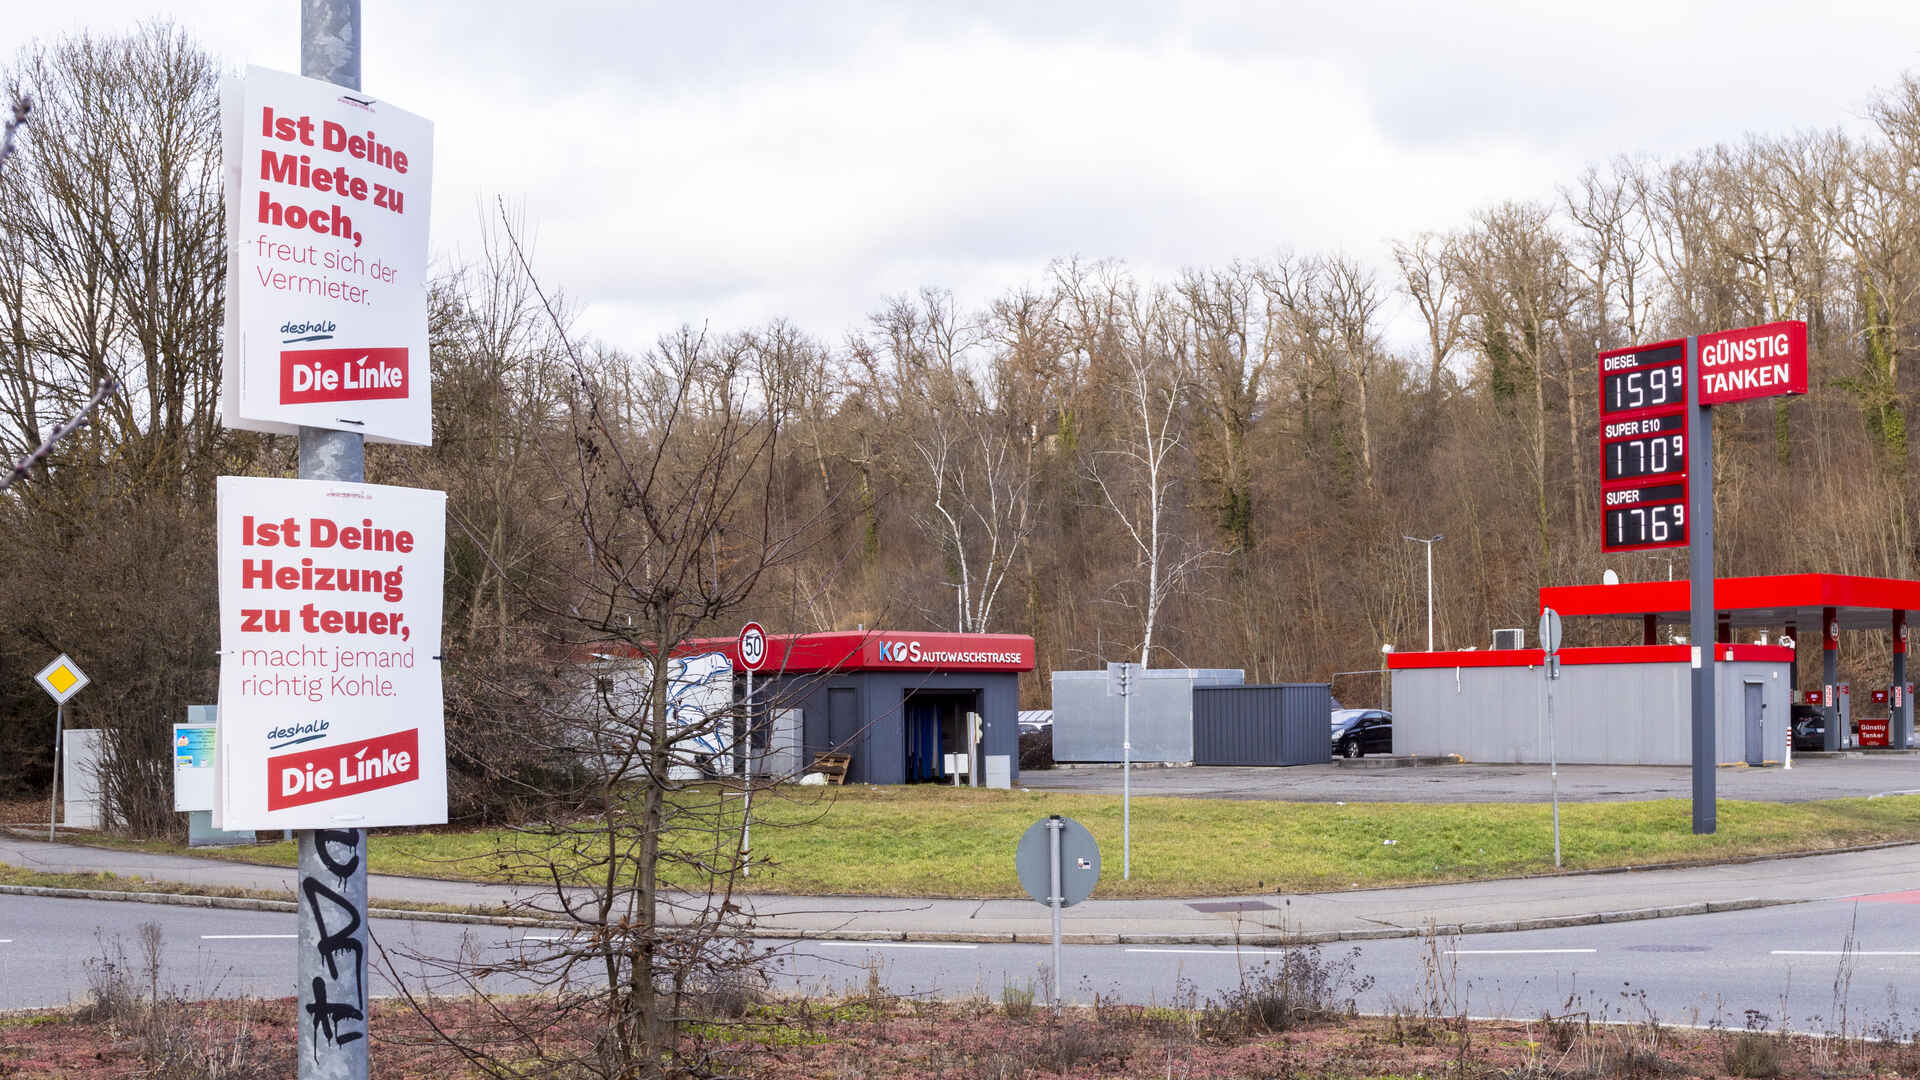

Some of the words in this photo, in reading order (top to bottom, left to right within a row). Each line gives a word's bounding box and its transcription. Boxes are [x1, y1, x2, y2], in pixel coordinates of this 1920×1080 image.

[262, 106, 315, 147] Ist
[322, 120, 409, 175] Deine
[260, 149, 368, 201] Miete
[373, 182, 404, 214] zu
[258, 191, 363, 248] hoch,
[256, 235, 318, 266] freut
[323, 249, 365, 277] sich
[370, 258, 398, 285] der
[256, 264, 371, 306] Vermieter.
[280, 320, 337, 334] deshalb
[1604, 354, 1639, 371] DIESEL
[1702, 333, 1789, 367] GÜNSTIG
[292, 361, 339, 393] Die
[344, 355, 403, 388] Linke
[1702, 363, 1790, 394] TANKEN
[1605, 422, 1639, 438] SUPER
[1642, 418, 1661, 433] E10
[1606, 489, 1640, 505] SUPER
[242, 515, 300, 548] Ist
[310, 518, 414, 554] Deine
[242, 558, 403, 602] Heizung
[241, 608, 290, 633] zu
[299, 604, 411, 642] teuer,
[241, 644, 328, 668] macht
[333, 645, 415, 673] jemand
[745, 635, 762, 657] 50
[921, 651, 1022, 664] AUTOWASCHSTRASSE
[241, 673, 323, 702] richtig
[330, 673, 398, 697] Kohle.
[267, 719, 330, 740] deshalb
[282, 763, 334, 798] Die
[339, 746, 412, 786] Linke
